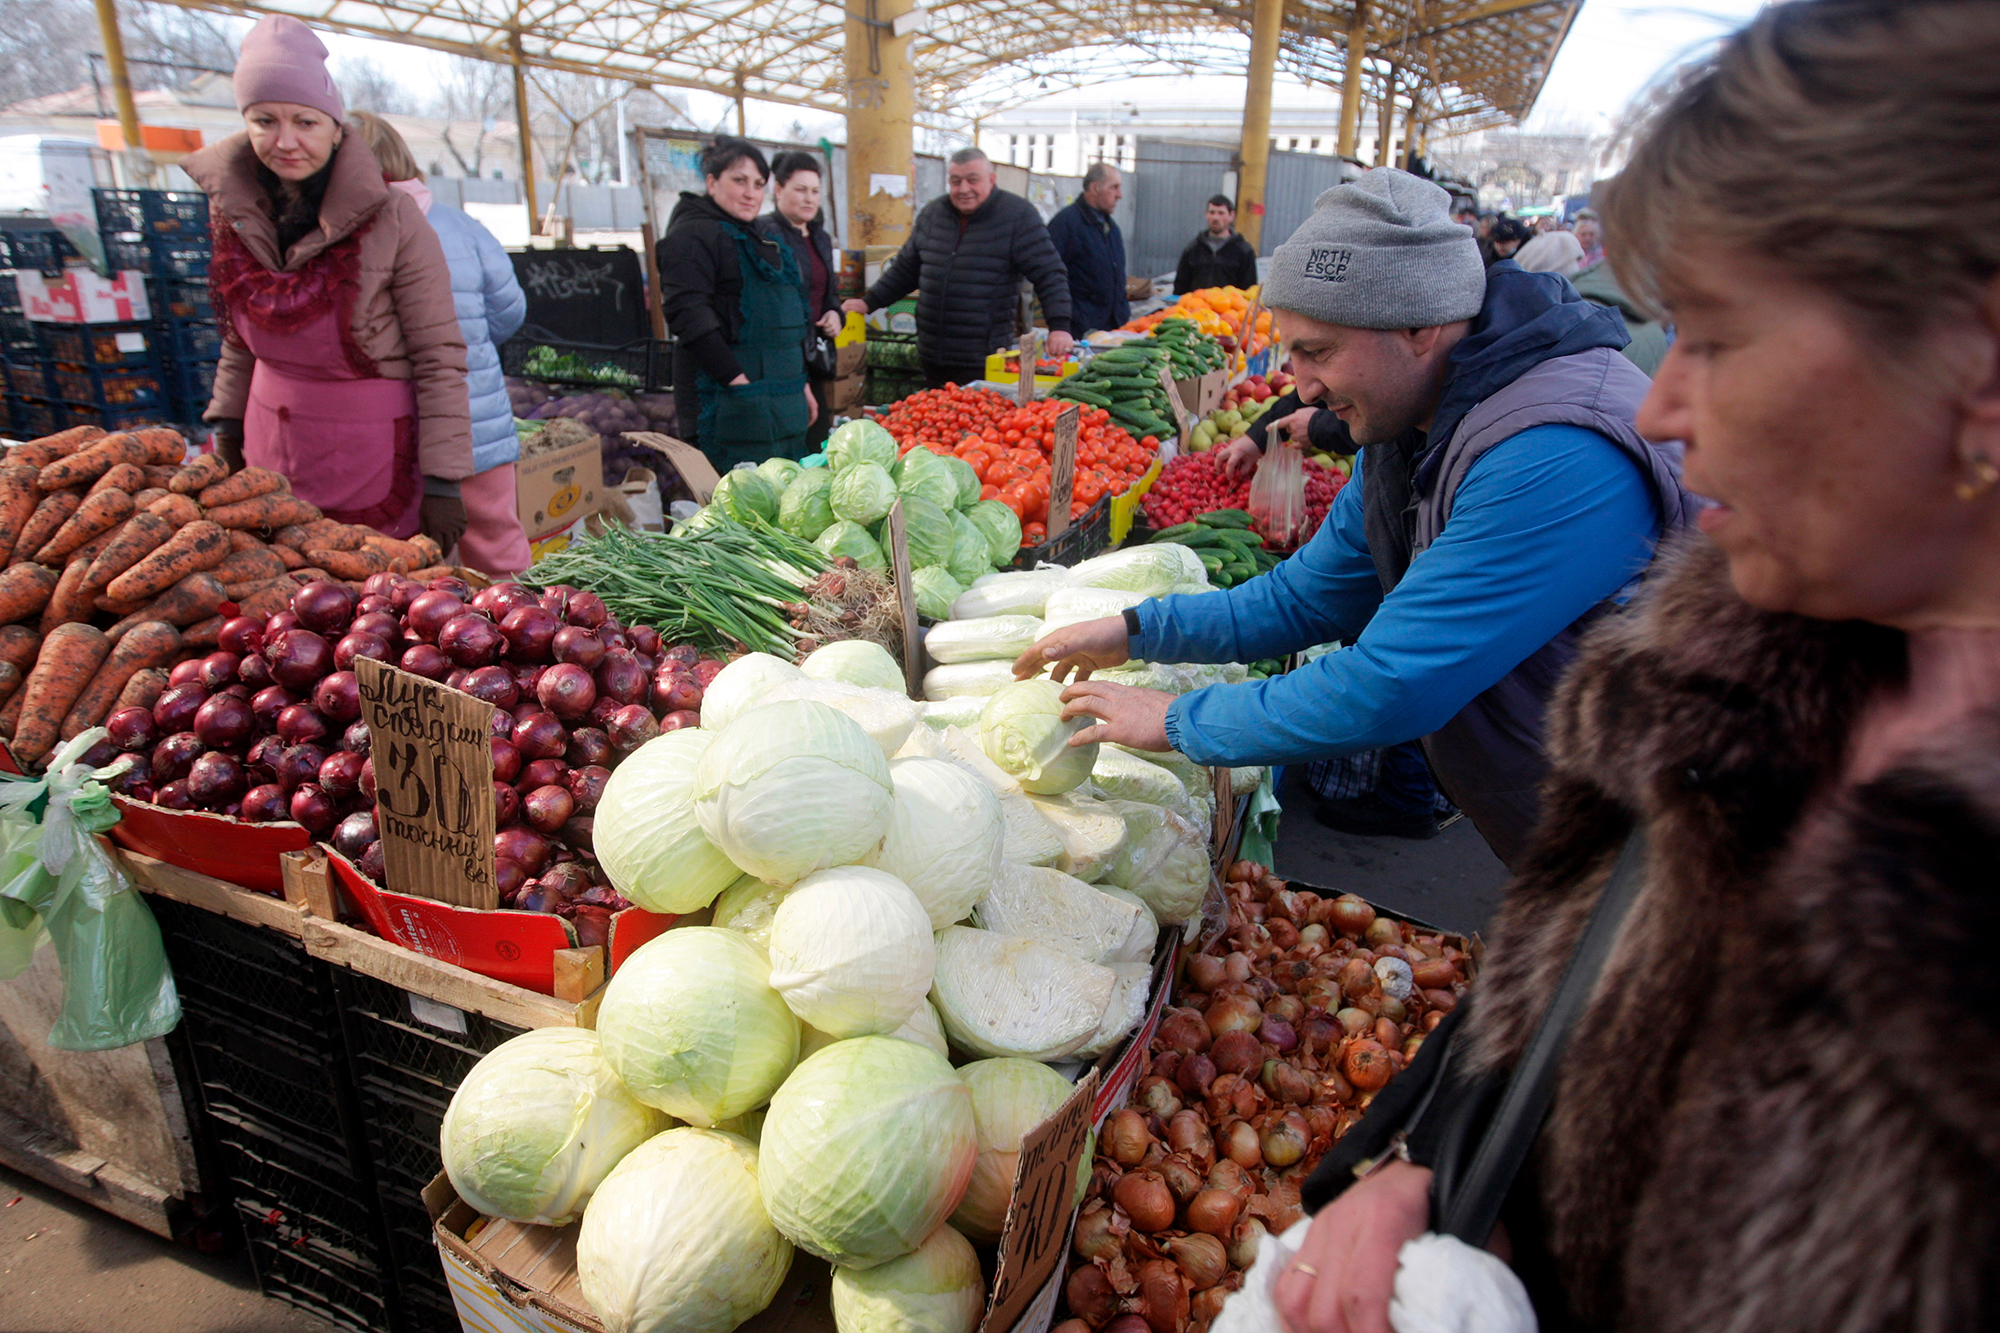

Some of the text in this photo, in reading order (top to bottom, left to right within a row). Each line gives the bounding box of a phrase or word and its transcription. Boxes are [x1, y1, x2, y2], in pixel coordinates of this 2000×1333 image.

[1310, 248, 1352, 265] NRTH
[1305, 261, 1347, 276] ESCP
[378, 742, 479, 838] 30
